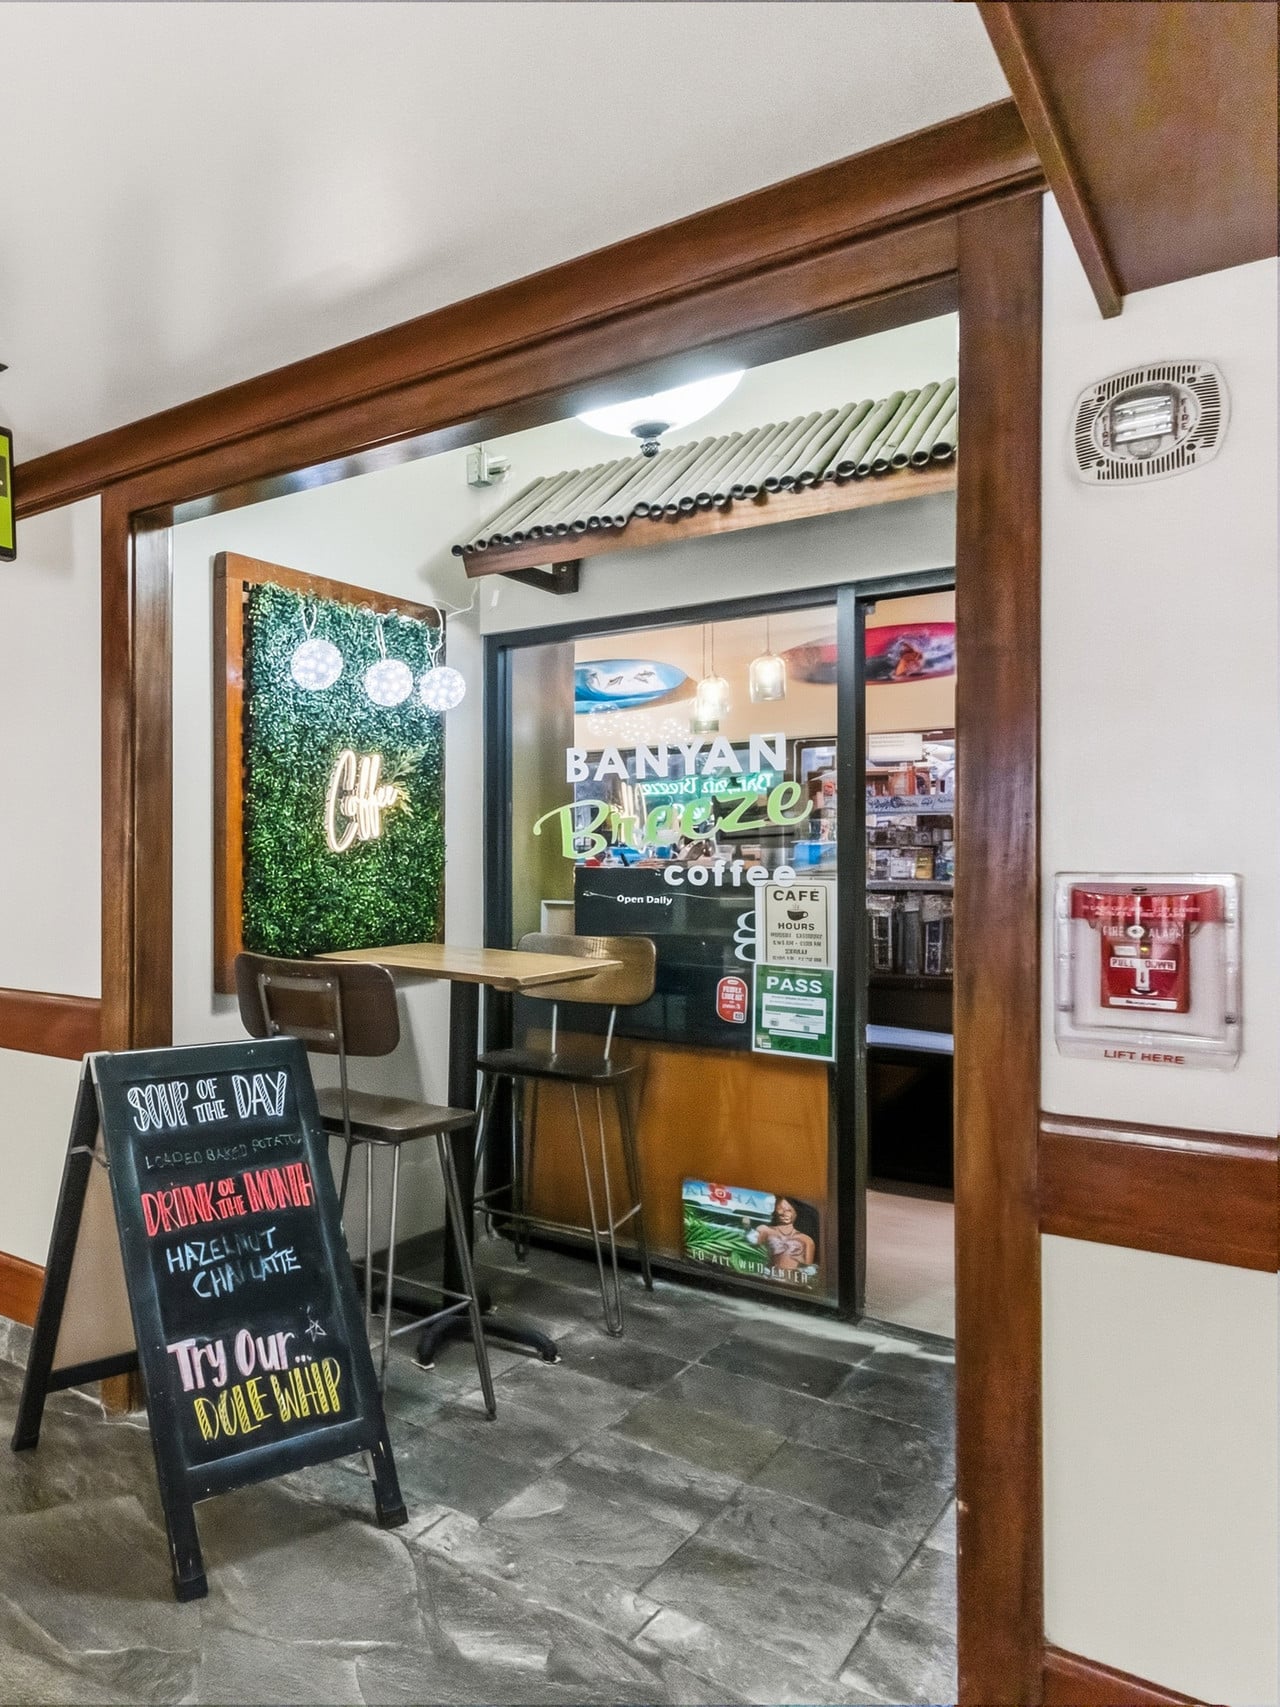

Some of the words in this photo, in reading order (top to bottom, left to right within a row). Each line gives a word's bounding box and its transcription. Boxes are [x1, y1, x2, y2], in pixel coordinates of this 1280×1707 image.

[566, 733, 787, 782] BANYAN
[533, 781, 813, 860] Breeze
[663, 860, 797, 887] coffee
[617, 894, 644, 905] Open
[646, 895, 673, 906] Daily
[777, 922, 815, 931] HOURS
[766, 976, 823, 994] PASS
[1103, 1050, 1136, 1061] LIFT
[1141, 1053, 1185, 1065] HERE
[196, 1078, 218, 1099] OF
[232, 1071, 287, 1119] DAY
[127, 1081, 189, 1132] SOUP
[192, 1100, 228, 1124] THE
[218, 1177, 236, 1197] OF
[141, 1181, 220, 1237] DRINK
[216, 1197, 246, 1218] THE
[166, 1226, 276, 1274] HAZELNUT
[250, 1246, 302, 1281] LATTE
[167, 1338, 228, 1391] Try
[193, 1376, 272, 1440] DOLE
[270, 1357, 341, 1422] WHIP
